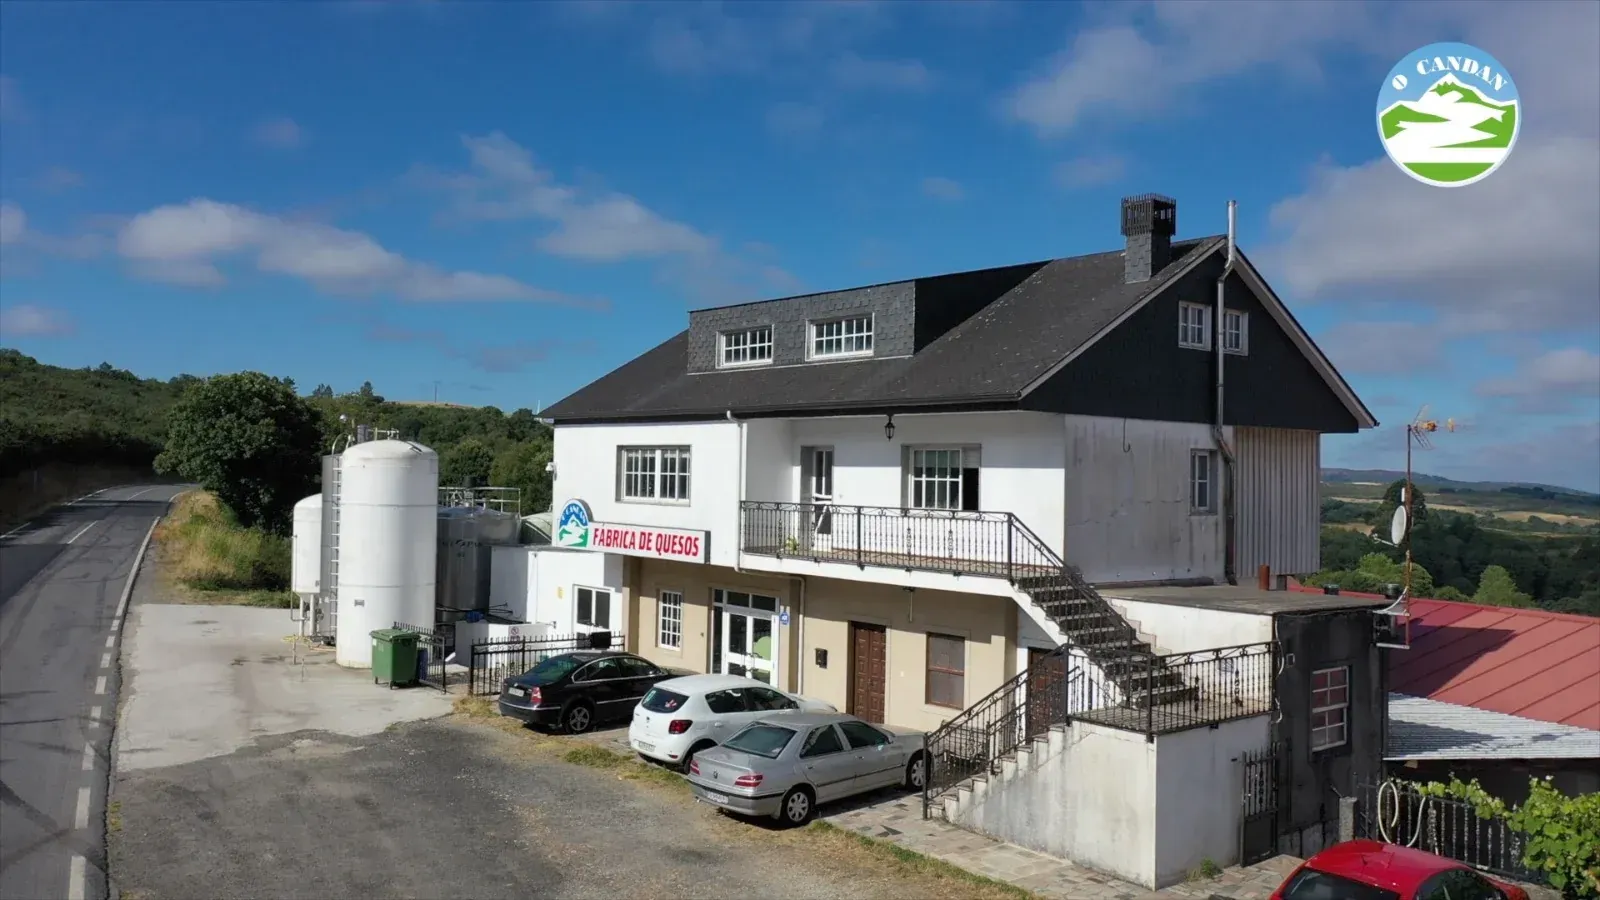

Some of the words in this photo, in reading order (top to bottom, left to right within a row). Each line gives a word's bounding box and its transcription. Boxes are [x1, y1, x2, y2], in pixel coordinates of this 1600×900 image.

[593, 528, 636, 550] FABRICA
[638, 532, 653, 551] DE
[655, 533, 700, 557] QUESOS
